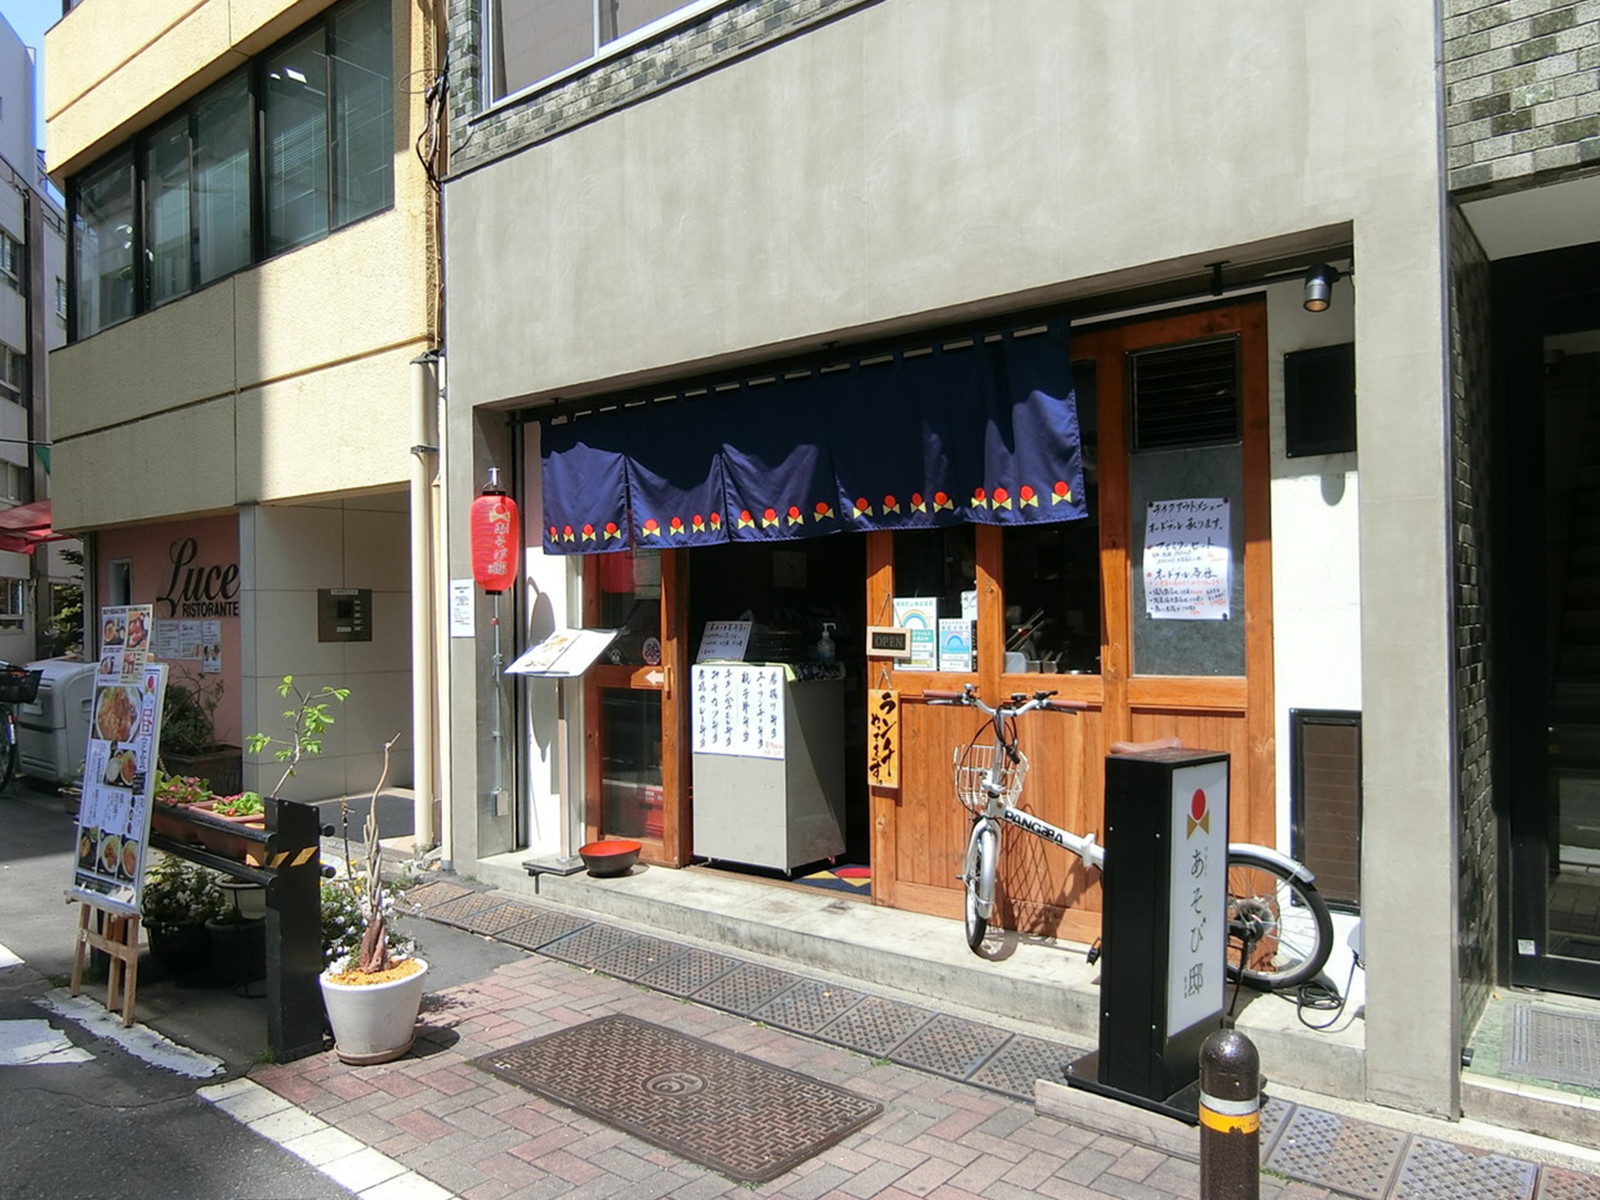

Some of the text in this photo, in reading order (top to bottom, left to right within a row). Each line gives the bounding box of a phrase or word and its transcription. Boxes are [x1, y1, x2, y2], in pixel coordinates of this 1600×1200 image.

[156, 538, 240, 617] Luce
[182, 601, 240, 617] RISTORANTE
[874, 635, 904, 648] OPEN
[879, 691, 897, 777] ランチ
[1187, 848, 1206, 996] あそび邸
